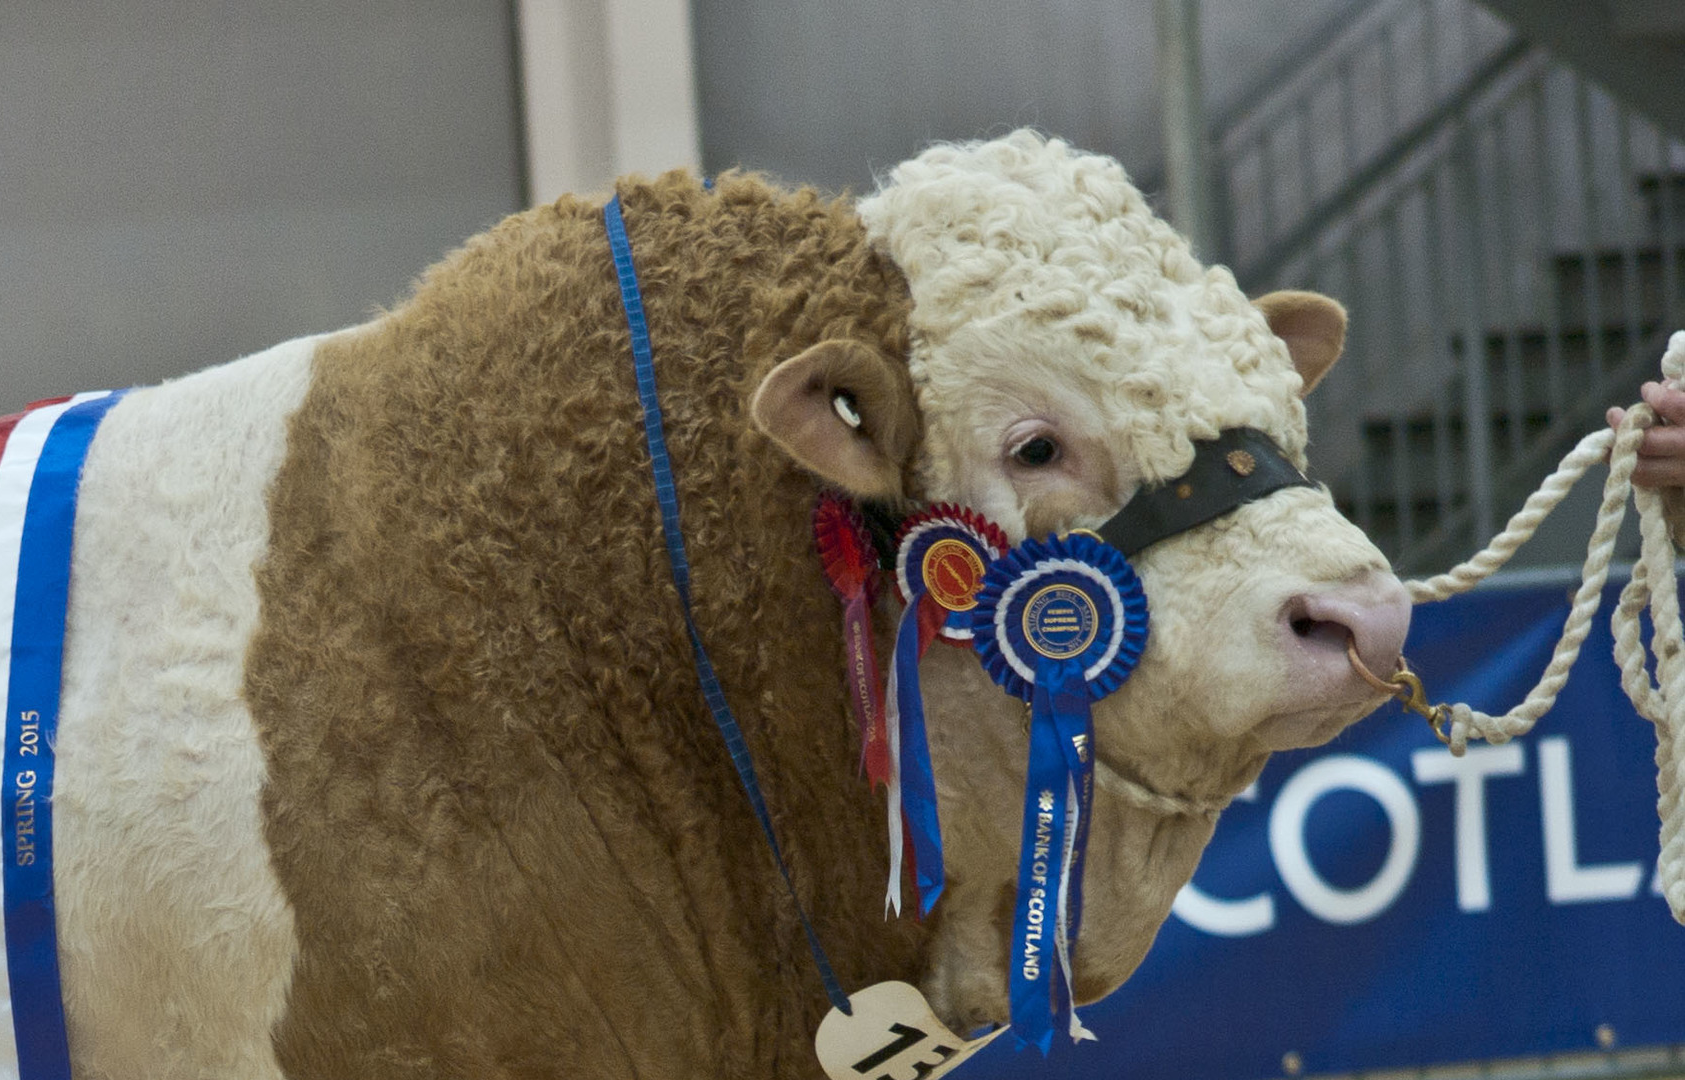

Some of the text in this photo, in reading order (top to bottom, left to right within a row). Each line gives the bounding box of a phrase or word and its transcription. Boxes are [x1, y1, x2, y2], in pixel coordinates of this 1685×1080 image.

[16, 710, 40, 866] SPRING 2015
[1023, 812, 1054, 982] BANK OF SCOTLAND
